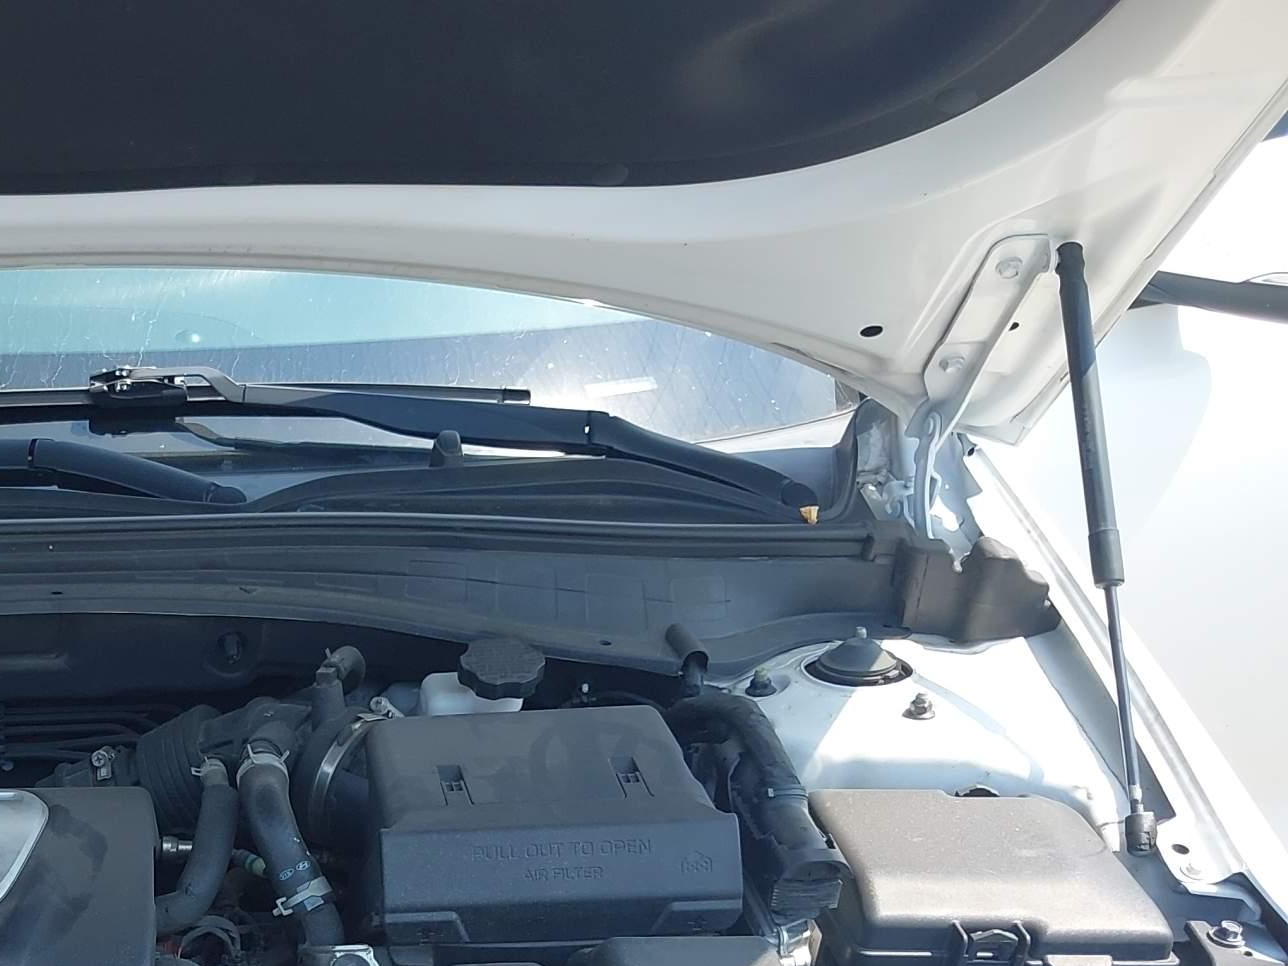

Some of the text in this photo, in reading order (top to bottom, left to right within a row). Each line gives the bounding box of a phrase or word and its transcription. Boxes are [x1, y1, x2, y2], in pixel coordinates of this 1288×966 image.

[472, 839, 651, 861] PULL OUT TO OPEN
[525, 865, 604, 881] AIR FILTER
